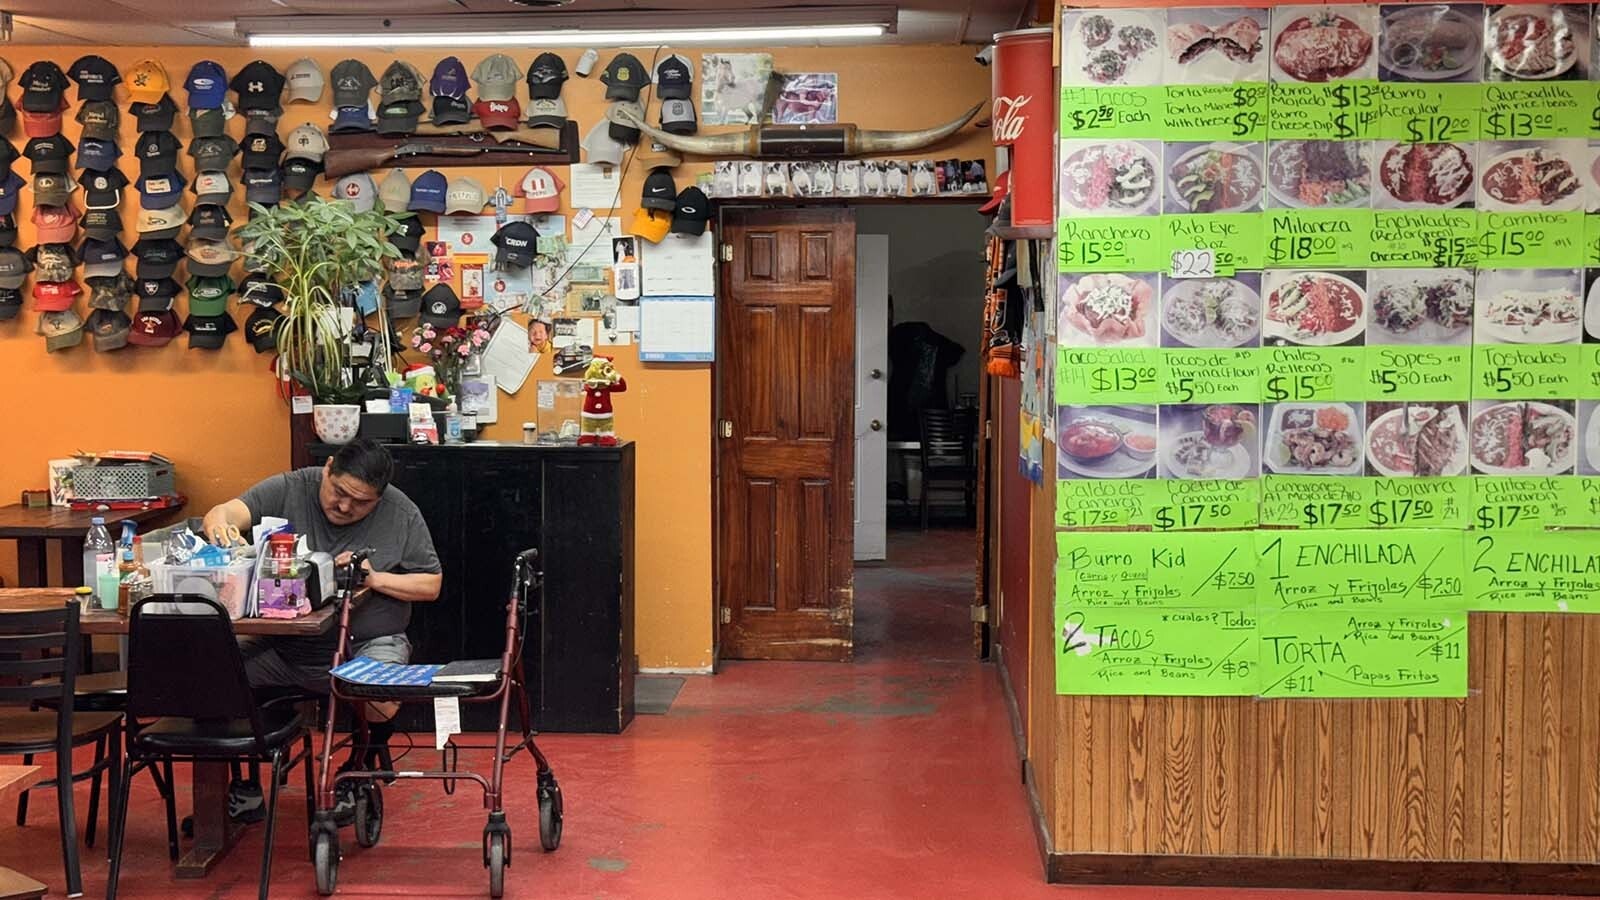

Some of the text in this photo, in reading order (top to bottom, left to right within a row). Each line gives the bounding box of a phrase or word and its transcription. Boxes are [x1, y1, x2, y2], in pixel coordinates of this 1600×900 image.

[1092, 87, 1147, 107] Tacos
[1164, 86, 1201, 99] Torta
[1270, 84, 1312, 97] Burro
[1380, 86, 1426, 100] Burro
[1487, 86, 1574, 103] Quesadilla
[1164, 102, 1201, 115] Torta
[1379, 103, 1440, 119] Regular
[1513, 101, 1539, 110] rice
[1118, 110, 1151, 123] Each
[1270, 110, 1308, 119] Burro
[1164, 117, 1193, 128] With
[1271, 119, 1314, 131] Cheese
[1315, 120, 1332, 133] Dip
[1170, 219, 1239, 237] Rib Eye
[1374, 213, 1470, 229] Enchiladas
[1488, 213, 1567, 229] Carnitas
[1065, 221, 1151, 241] Ranchero
[1411, 251, 1432, 264] Dip
[1062, 349, 1145, 365] Taco Salad
[1165, 352, 1206, 366] Tacos
[1208, 353, 1228, 366] de
[1273, 350, 1321, 363] Chiles
[1380, 350, 1441, 369] Sopes
[1482, 349, 1566, 366] Tostadas
[1266, 362, 1332, 374] Rellenos
[1424, 372, 1452, 384] Each
[1539, 374, 1569, 385] Each
[1217, 382, 1239, 392] Each
[1062, 481, 1146, 497] Caldo de
[1224, 479, 1245, 492] de
[1374, 479, 1456, 496] Mojarra
[1475, 478, 1564, 493] Fajitas de
[1066, 495, 1141, 511] Camaron
[1170, 494, 1240, 505] Camaron
[1069, 547, 1186, 569] Burro Kid
[1262, 537, 1416, 580] 1 ENCHILADA
[1473, 535, 1496, 574] 2
[1275, 581, 1317, 601] Arroz
[1328, 582, 1339, 597] y
[1347, 577, 1408, 599] Frijoles
[1489, 576, 1528, 588] Arroz
[1538, 580, 1546, 589] y
[1071, 584, 1181, 601] Arroz y Frijoles
[1489, 590, 1589, 603] Rice and Beans
[1086, 598, 1108, 606] Rice
[1136, 598, 1163, 606] Beans
[1297, 601, 1319, 609] Rice
[1221, 611, 1257, 628] Todos
[1348, 617, 1445, 632] Arroz y Frijoles
[1063, 611, 1155, 654] 2 TACOS
[1353, 631, 1379, 645] Rice
[1410, 631, 1440, 641] Beans
[1262, 635, 1346, 664] TORTA
[1430, 641, 1460, 663] $11
[1102, 653, 1141, 664] Arroz
[1151, 655, 1159, 665] y
[1164, 653, 1213, 669] Frijoles
[1098, 668, 1196, 681] Rice and Beans
[1347, 667, 1440, 686] Papas Fritas
[1284, 675, 1314, 693] $11
